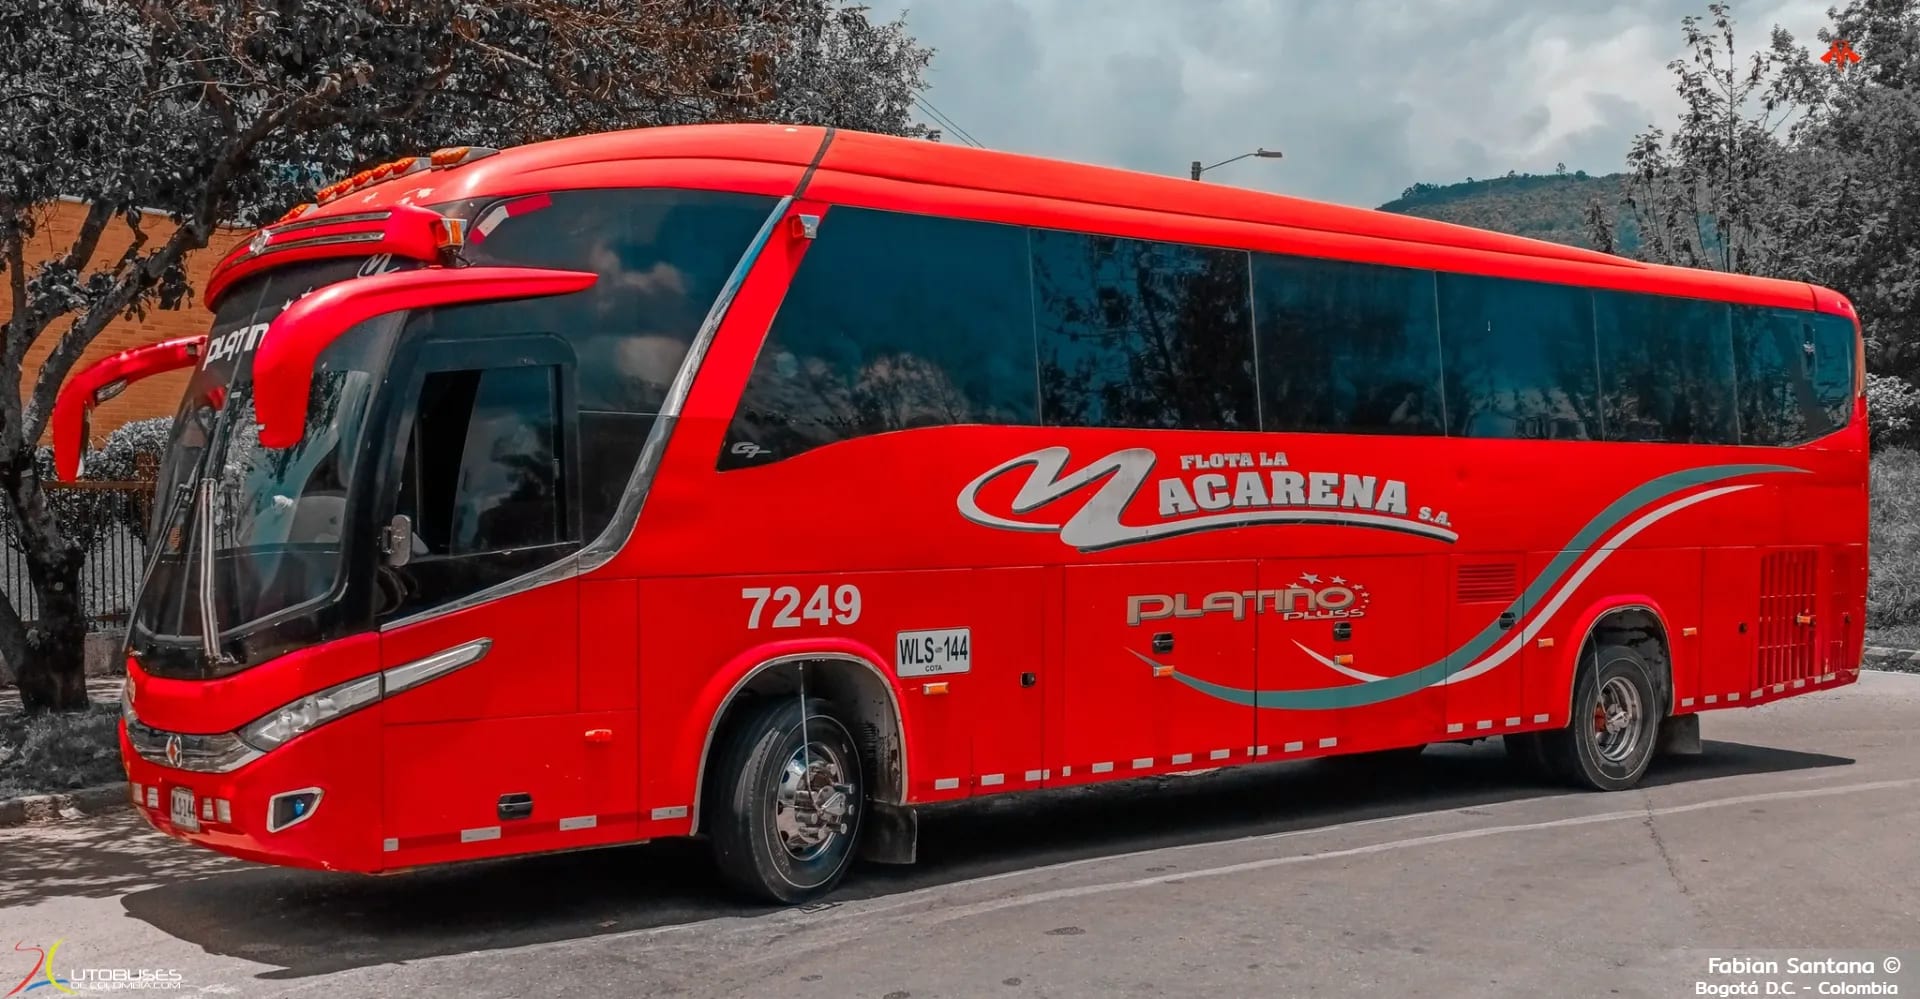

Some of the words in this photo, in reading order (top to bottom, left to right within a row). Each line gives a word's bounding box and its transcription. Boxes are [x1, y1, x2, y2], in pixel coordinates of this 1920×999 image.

[1180, 452, 1254, 470] FLOTA
[1259, 452, 1288, 467] LA
[1418, 506, 1452, 527] S.A.
[742, 584, 862, 630] 7249
[1126, 586, 1355, 627] PLATINO
[1283, 608, 1365, 621] PLUSS
[925, 664, 942, 672] COTA
